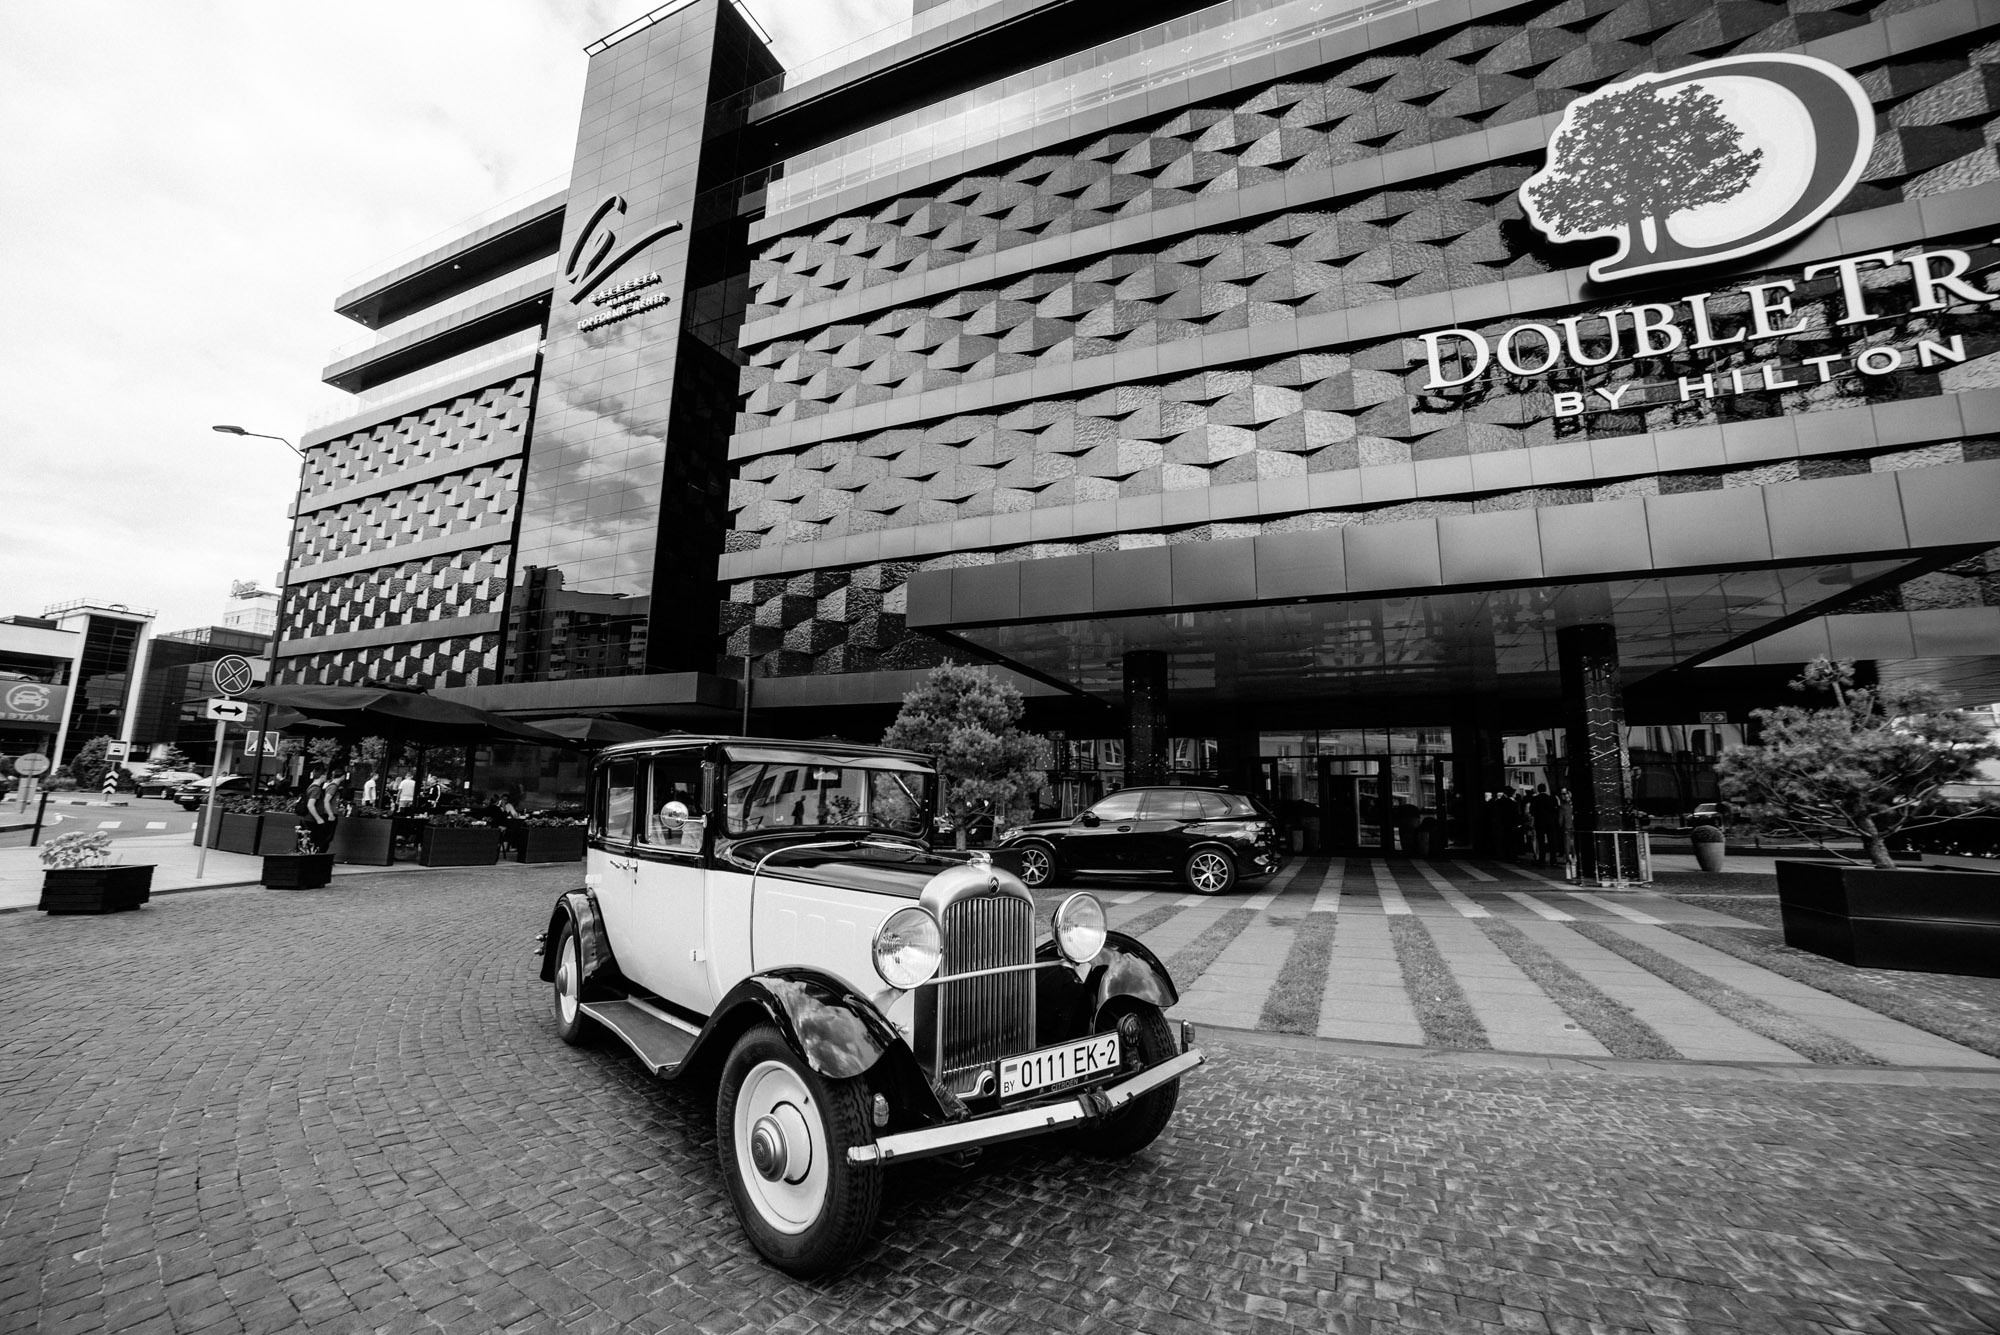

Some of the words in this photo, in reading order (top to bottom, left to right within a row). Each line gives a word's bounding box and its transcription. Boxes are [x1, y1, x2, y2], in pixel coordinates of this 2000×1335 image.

[1418, 238, 2000, 390] DOUBLETR
[1553, 384, 1630, 418] BY
[1678, 334, 1967, 402] HILTON
[1003, 1080, 1016, 1093] BY
[1022, 1051, 1064, 1087] 0111
[1074, 1039, 1116, 1075] EK-2
